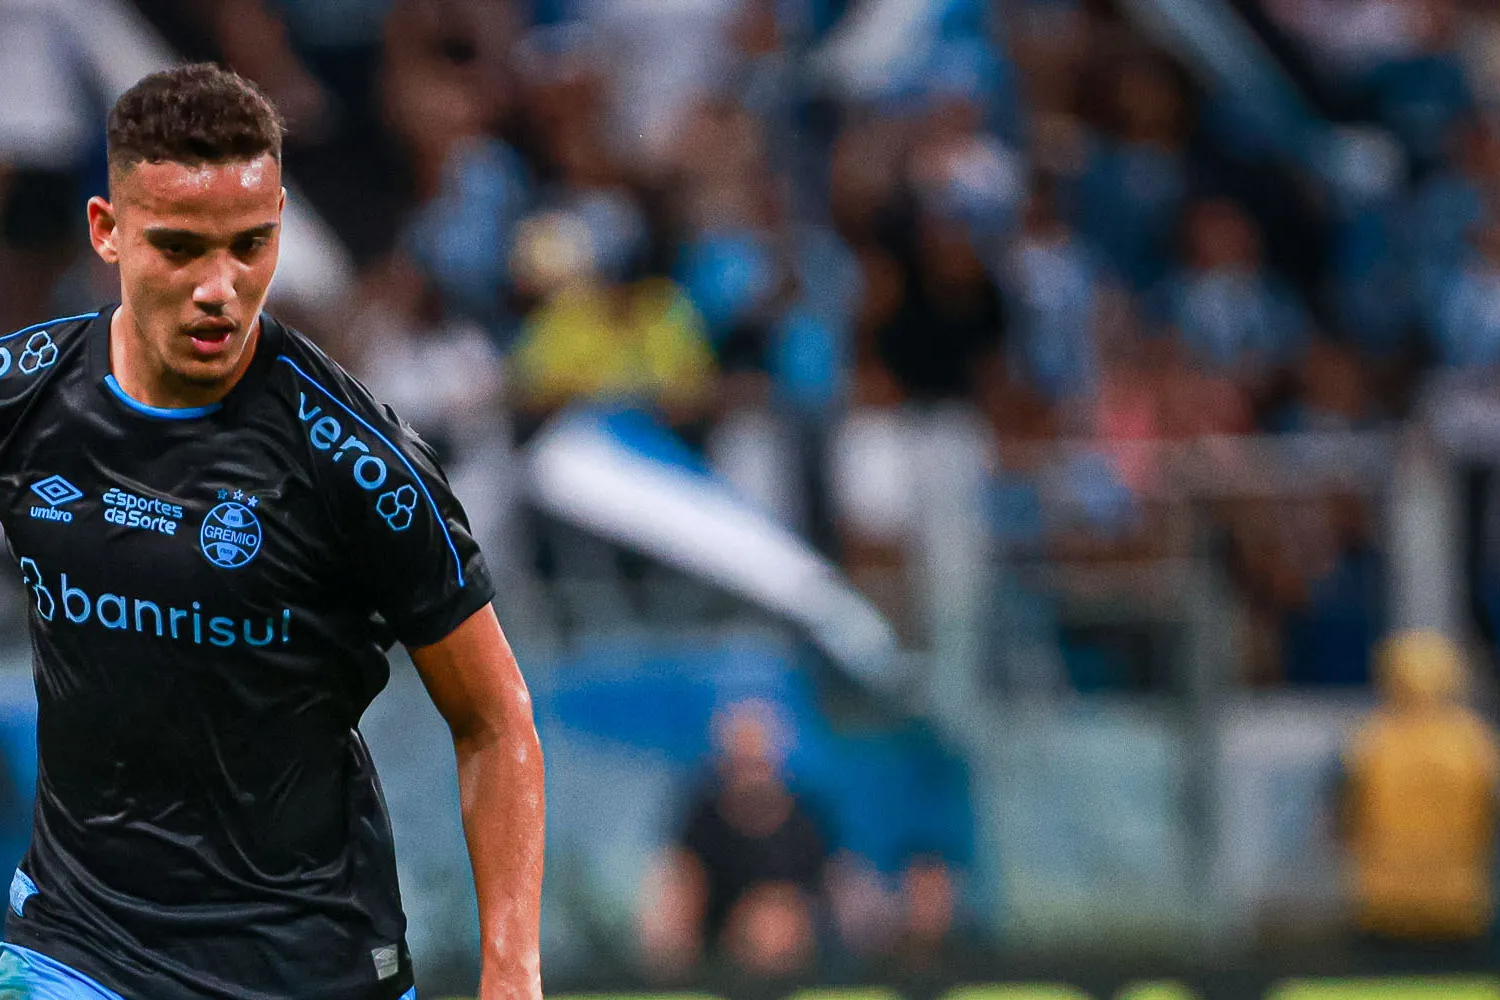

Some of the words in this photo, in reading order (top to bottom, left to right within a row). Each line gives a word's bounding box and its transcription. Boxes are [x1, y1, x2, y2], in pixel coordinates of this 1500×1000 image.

[298, 391, 387, 490] vero
[30, 505, 73, 523] umbro
[60, 572, 291, 647] banrisul
